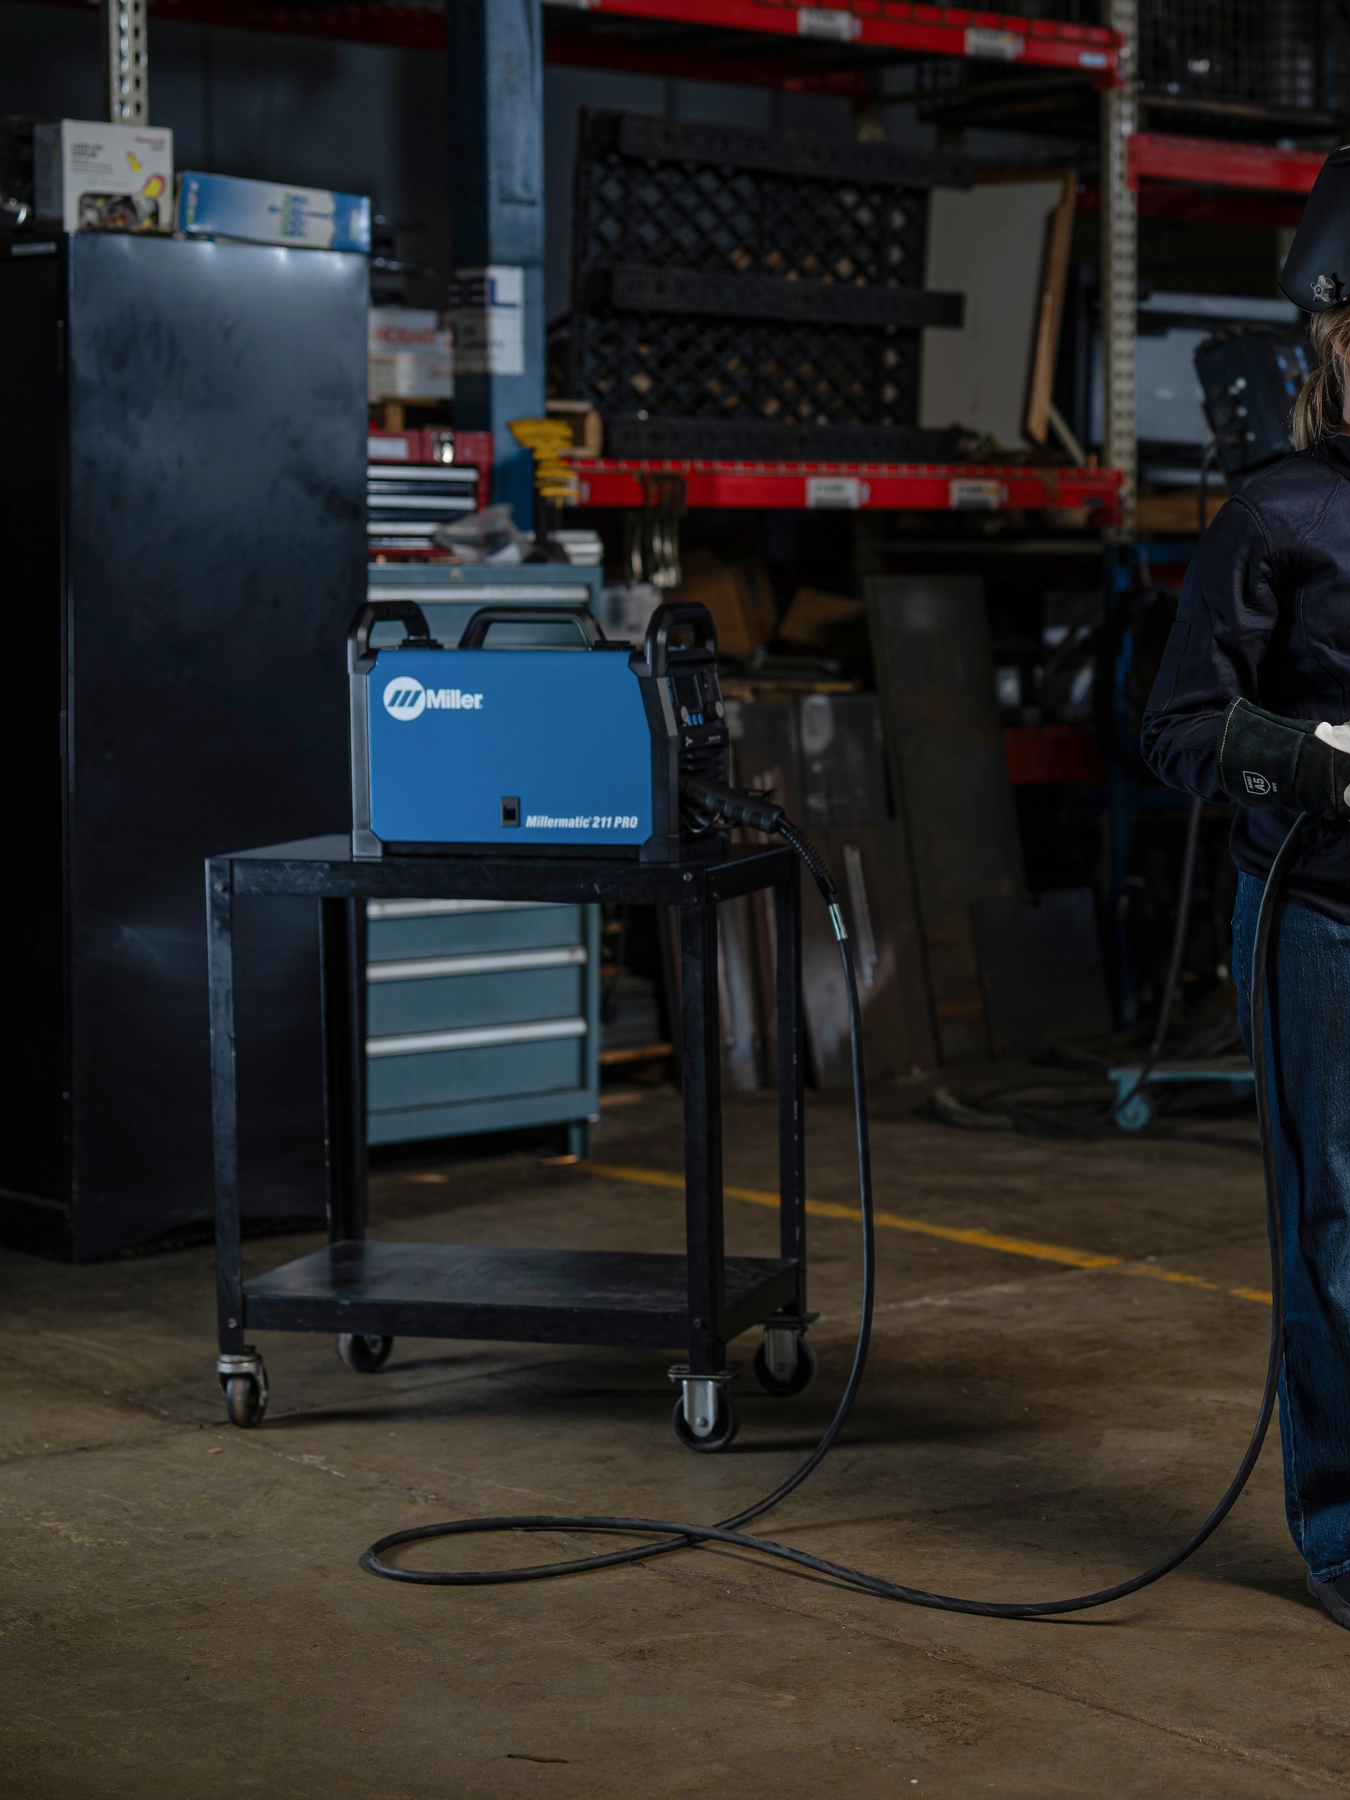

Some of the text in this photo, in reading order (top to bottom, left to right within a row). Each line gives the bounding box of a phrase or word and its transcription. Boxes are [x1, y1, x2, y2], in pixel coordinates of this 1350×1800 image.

[426, 688, 483, 709] Miller
[1252, 777, 1266, 792] A5
[525, 814, 638, 829] Millermatic 211 PRO
